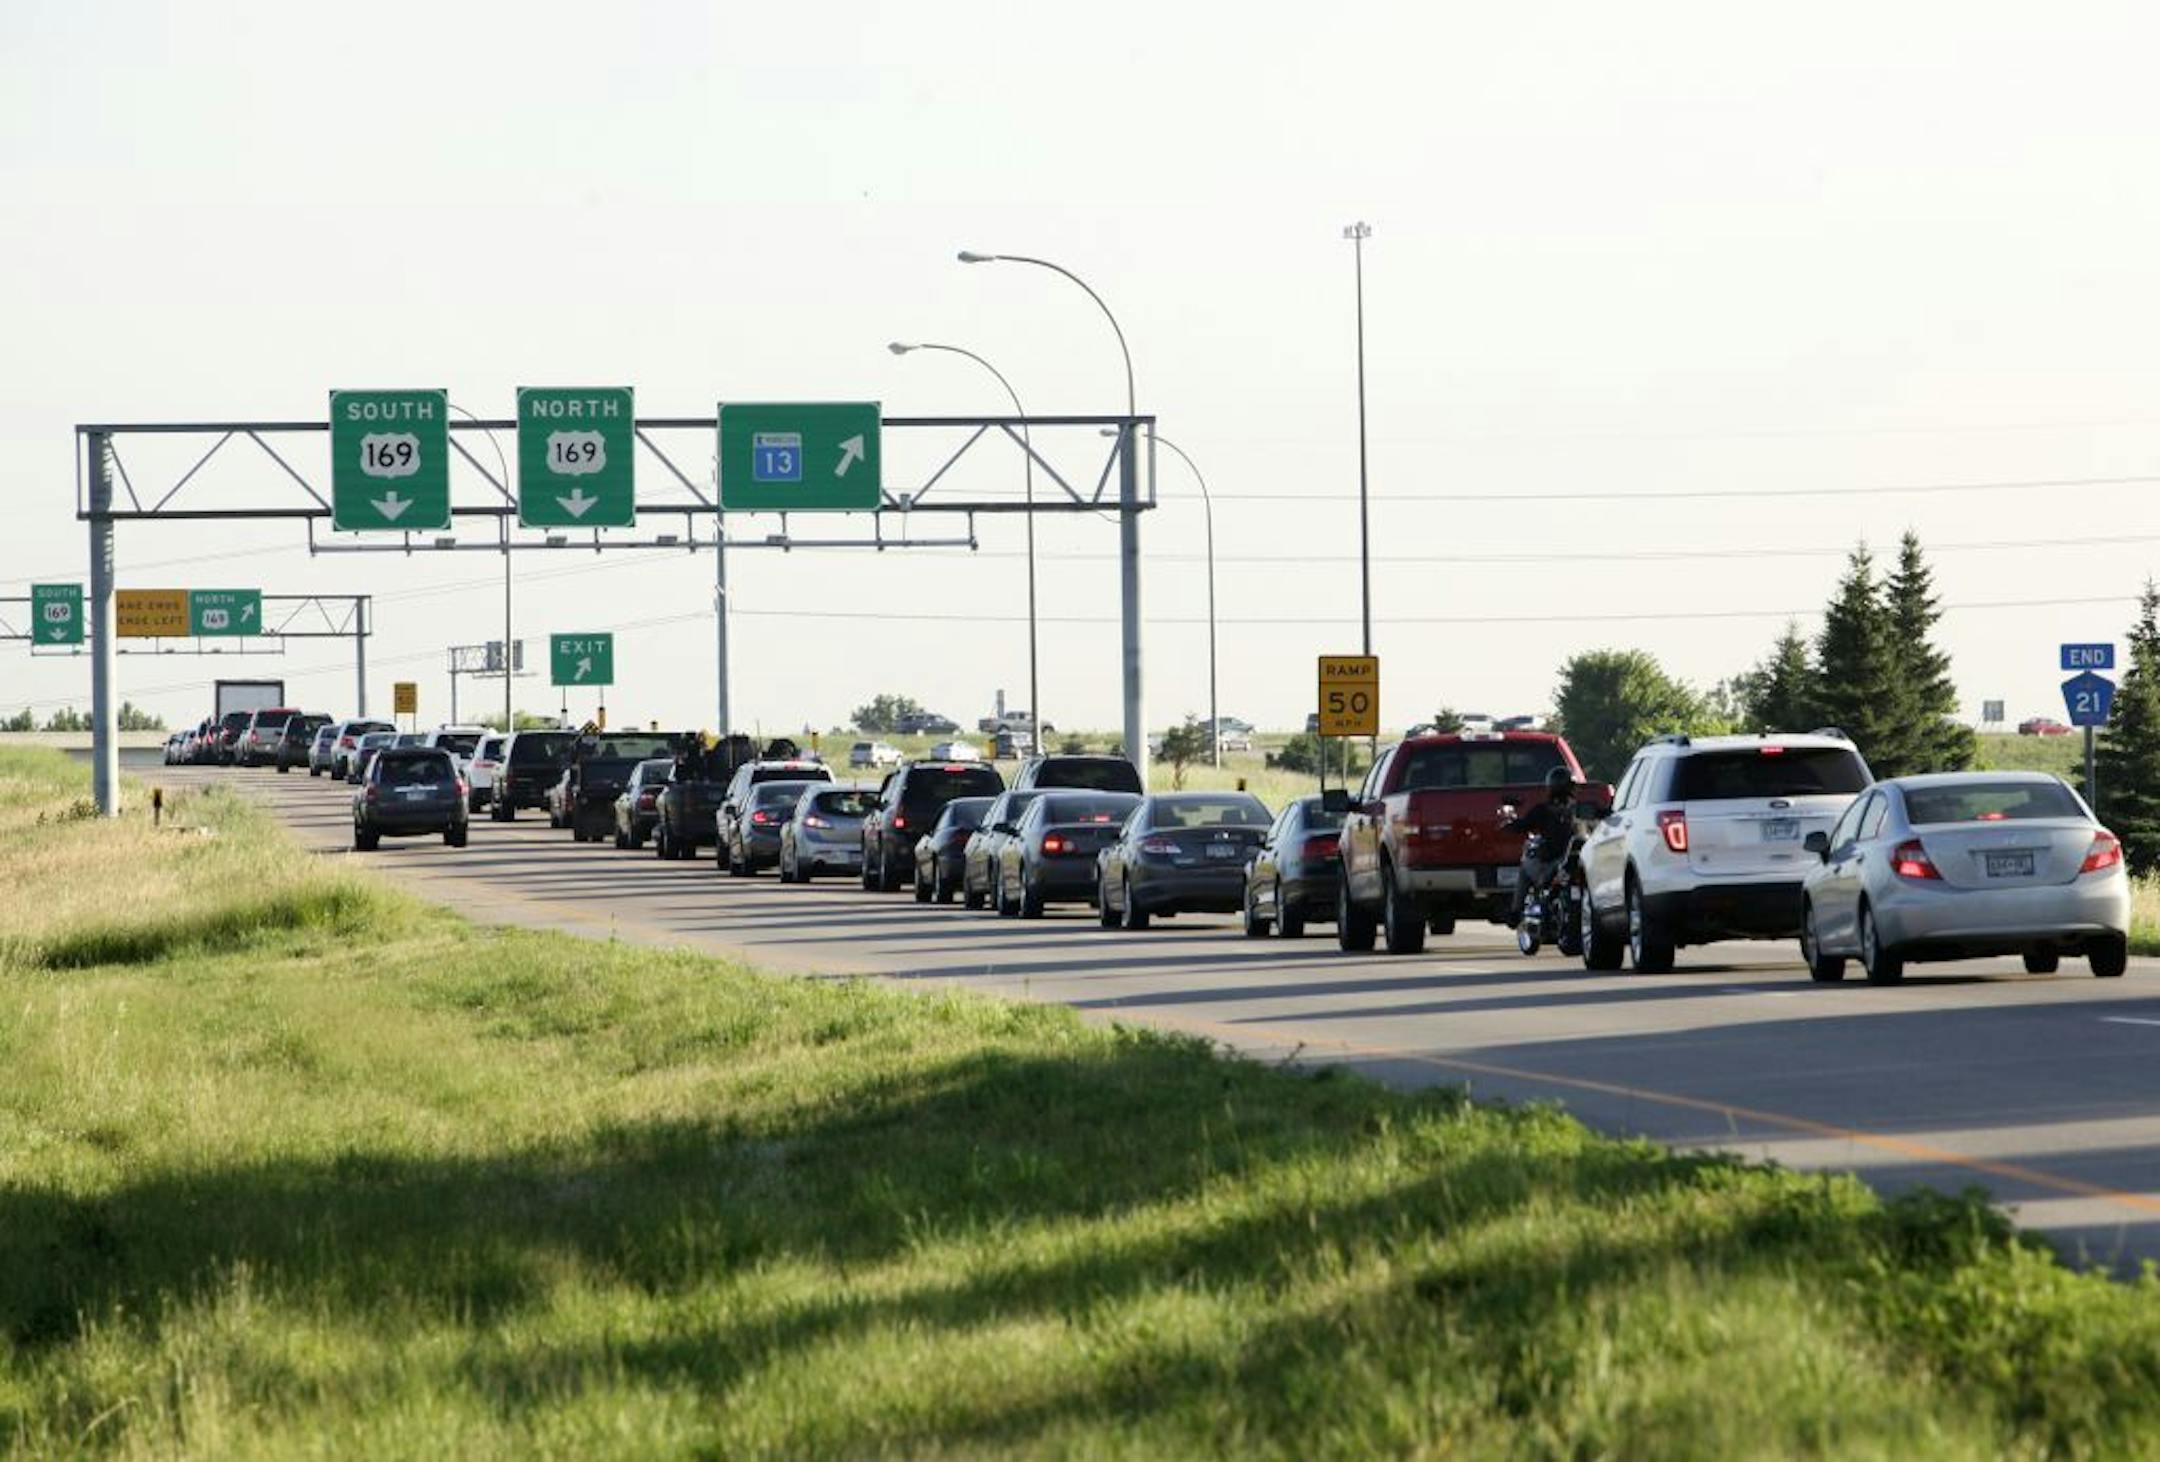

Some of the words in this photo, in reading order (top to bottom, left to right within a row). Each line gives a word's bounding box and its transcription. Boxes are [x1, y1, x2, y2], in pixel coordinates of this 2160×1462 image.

[347, 402, 434, 420] SOUTH
[532, 400, 618, 418] NORTH
[367, 442, 412, 467] 169
[556, 441, 596, 463] 169
[765, 450, 792, 474] 13
[37, 587, 78, 598] SOUTH
[195, 594, 235, 604] NORTH
[48, 607, 69, 619] 169
[118, 601, 142, 610] ANE
[205, 613, 226, 624] 169
[560, 640, 606, 653] EXIT
[2070, 648, 2105, 666] END
[1326, 664, 1372, 676] RAMP
[1328, 692, 1369, 714] 50
[2076, 691, 2100, 712] 21
